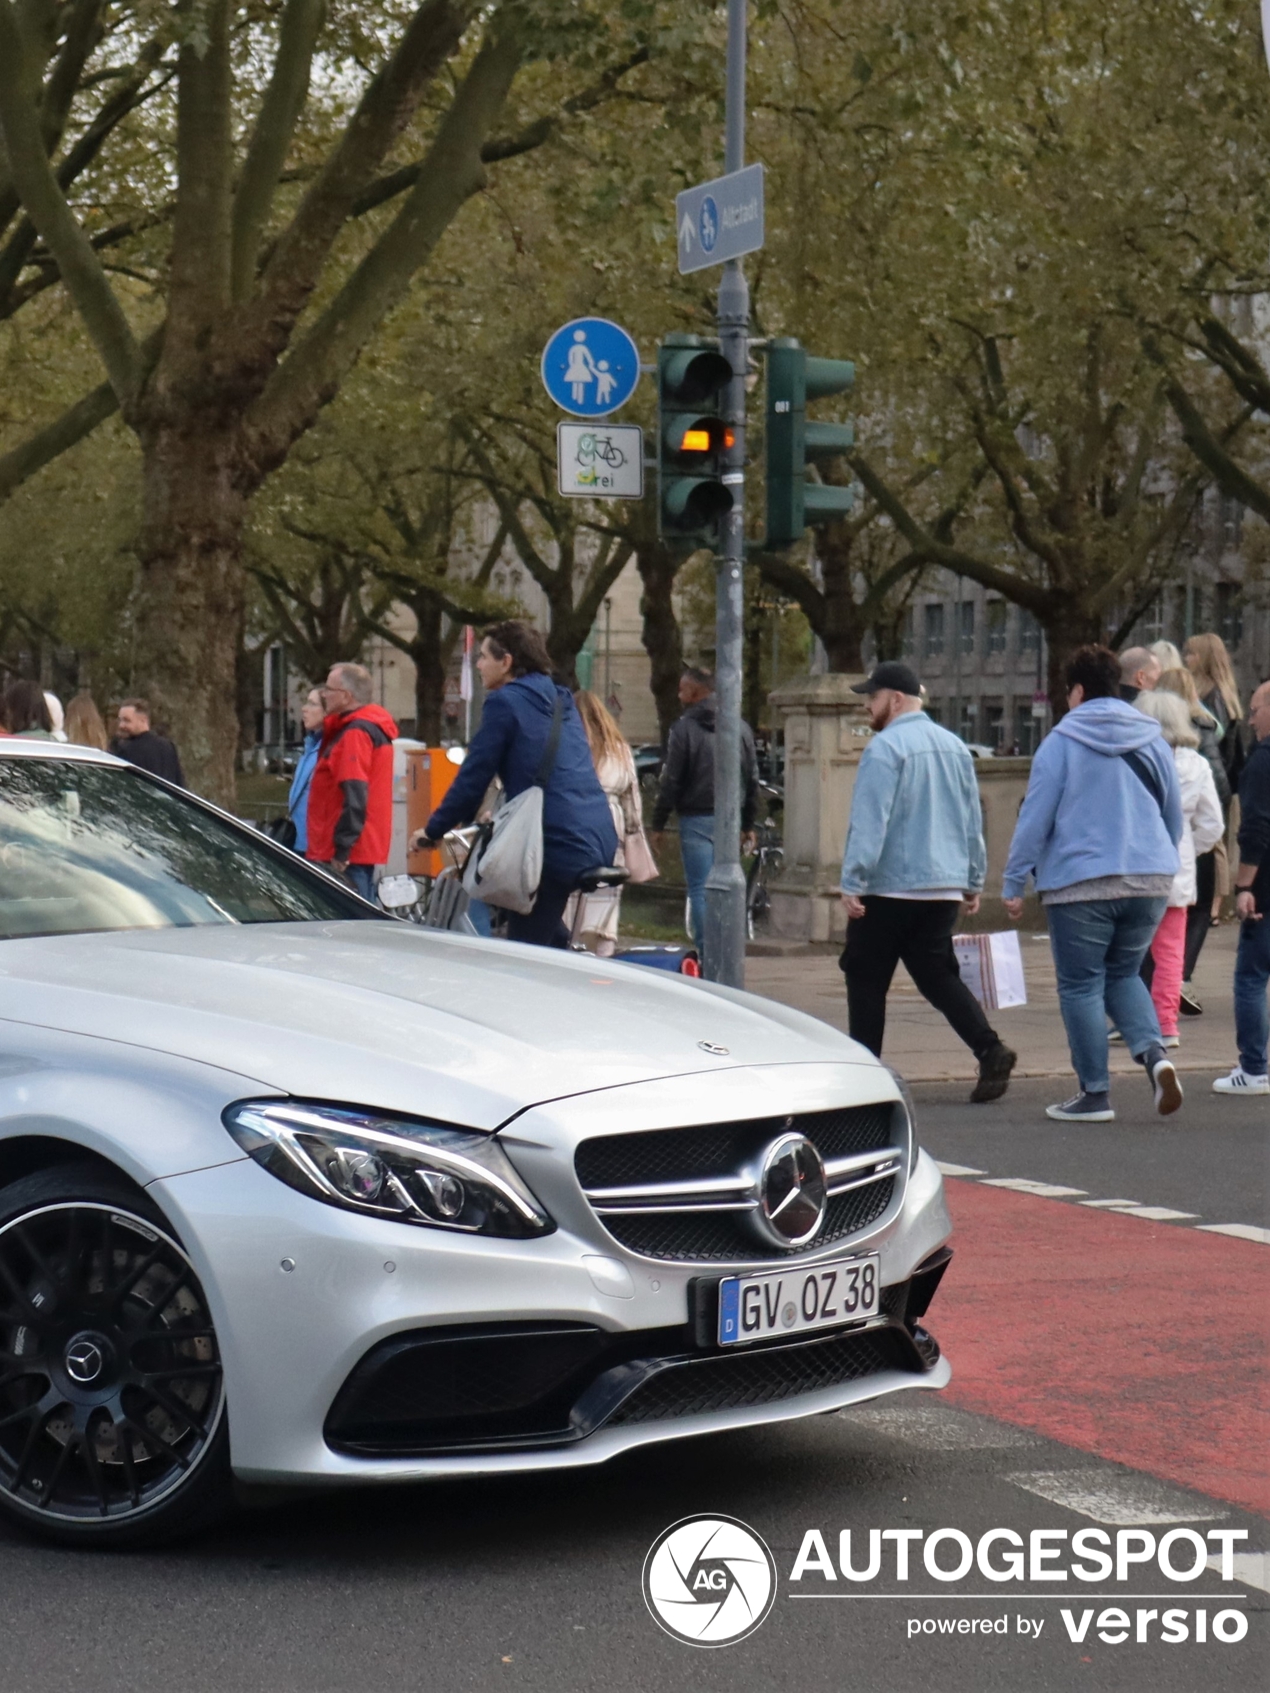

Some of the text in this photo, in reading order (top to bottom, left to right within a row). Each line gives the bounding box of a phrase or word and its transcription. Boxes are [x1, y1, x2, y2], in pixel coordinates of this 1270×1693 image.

[742, 1262, 876, 1332] GV OZ 38
[725, 1319, 733, 1333] D
